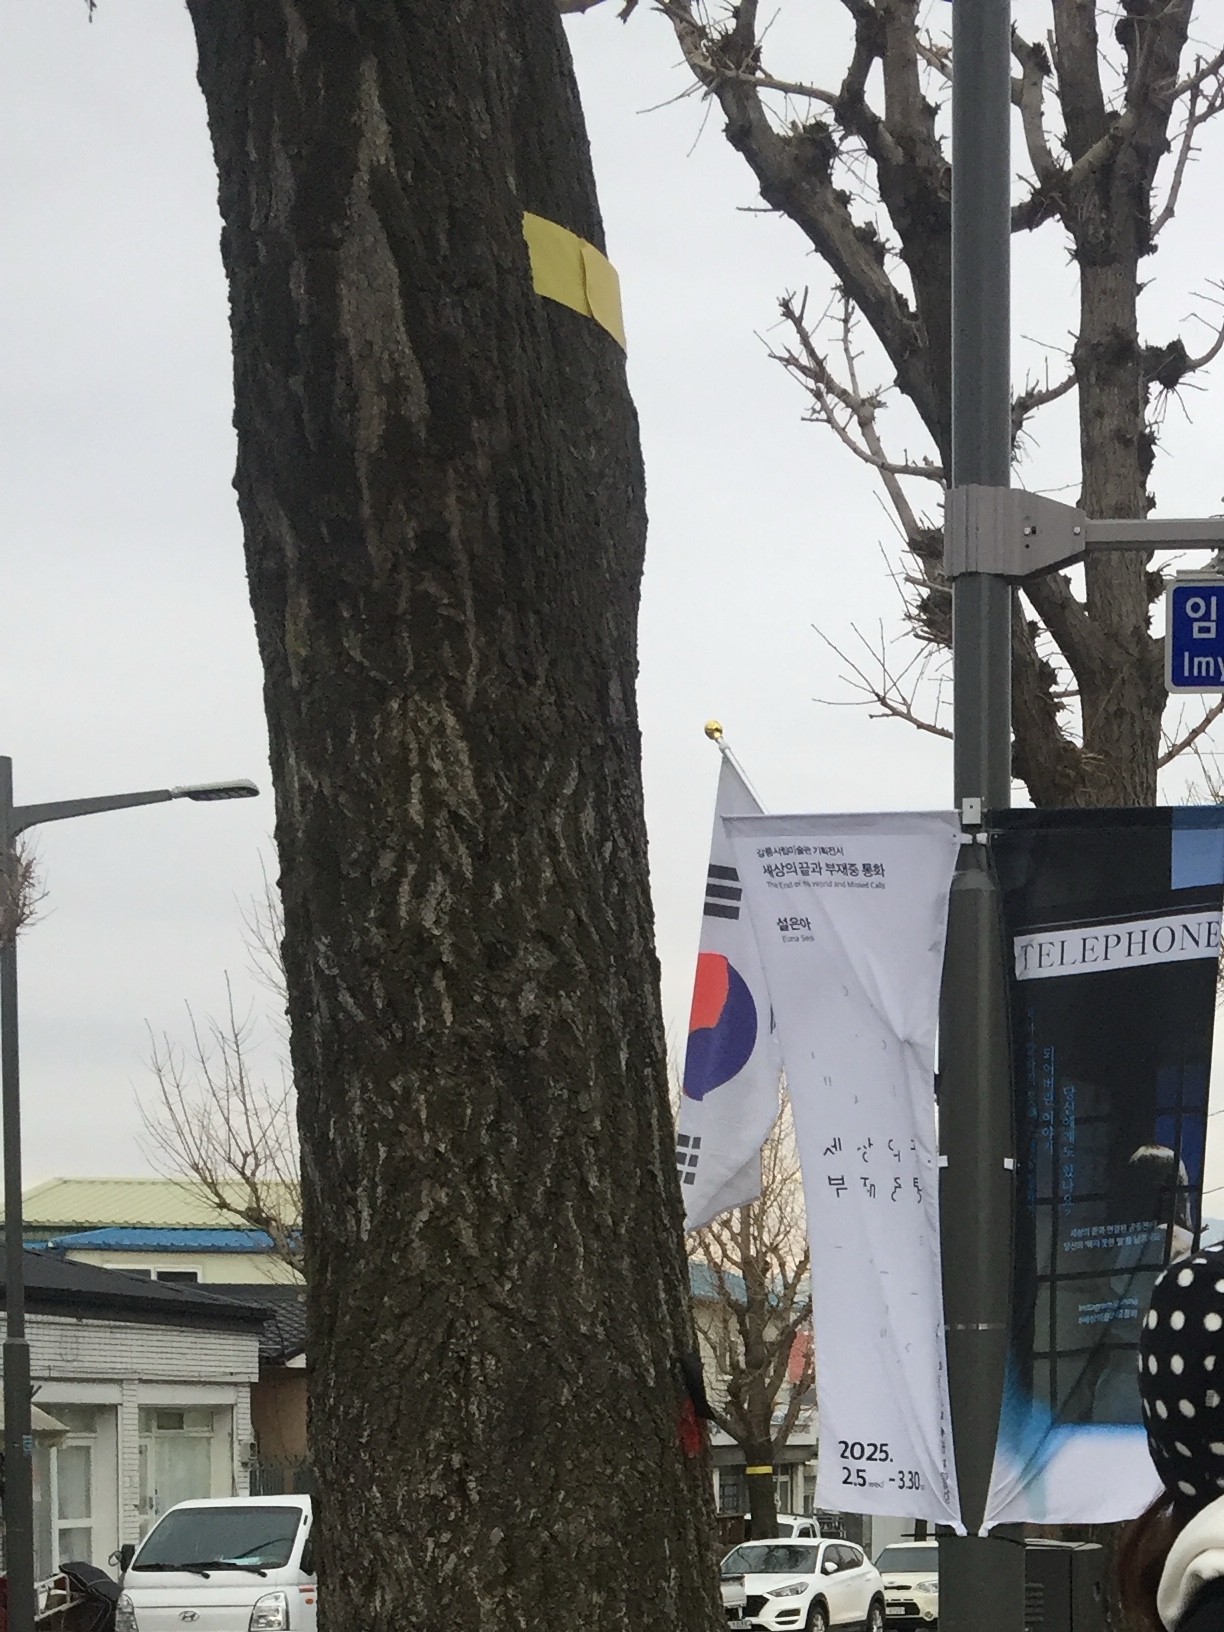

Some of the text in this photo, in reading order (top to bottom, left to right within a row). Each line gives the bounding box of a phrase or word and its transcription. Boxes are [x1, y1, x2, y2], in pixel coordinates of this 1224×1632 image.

[762, 860, 886, 878] 세상의 끝과 부재중 통화
[776, 917, 812, 932] 설은아
[1019, 920, 1221, 972] TELEPHONE
[838, 1440, 894, 1463] 2025.
